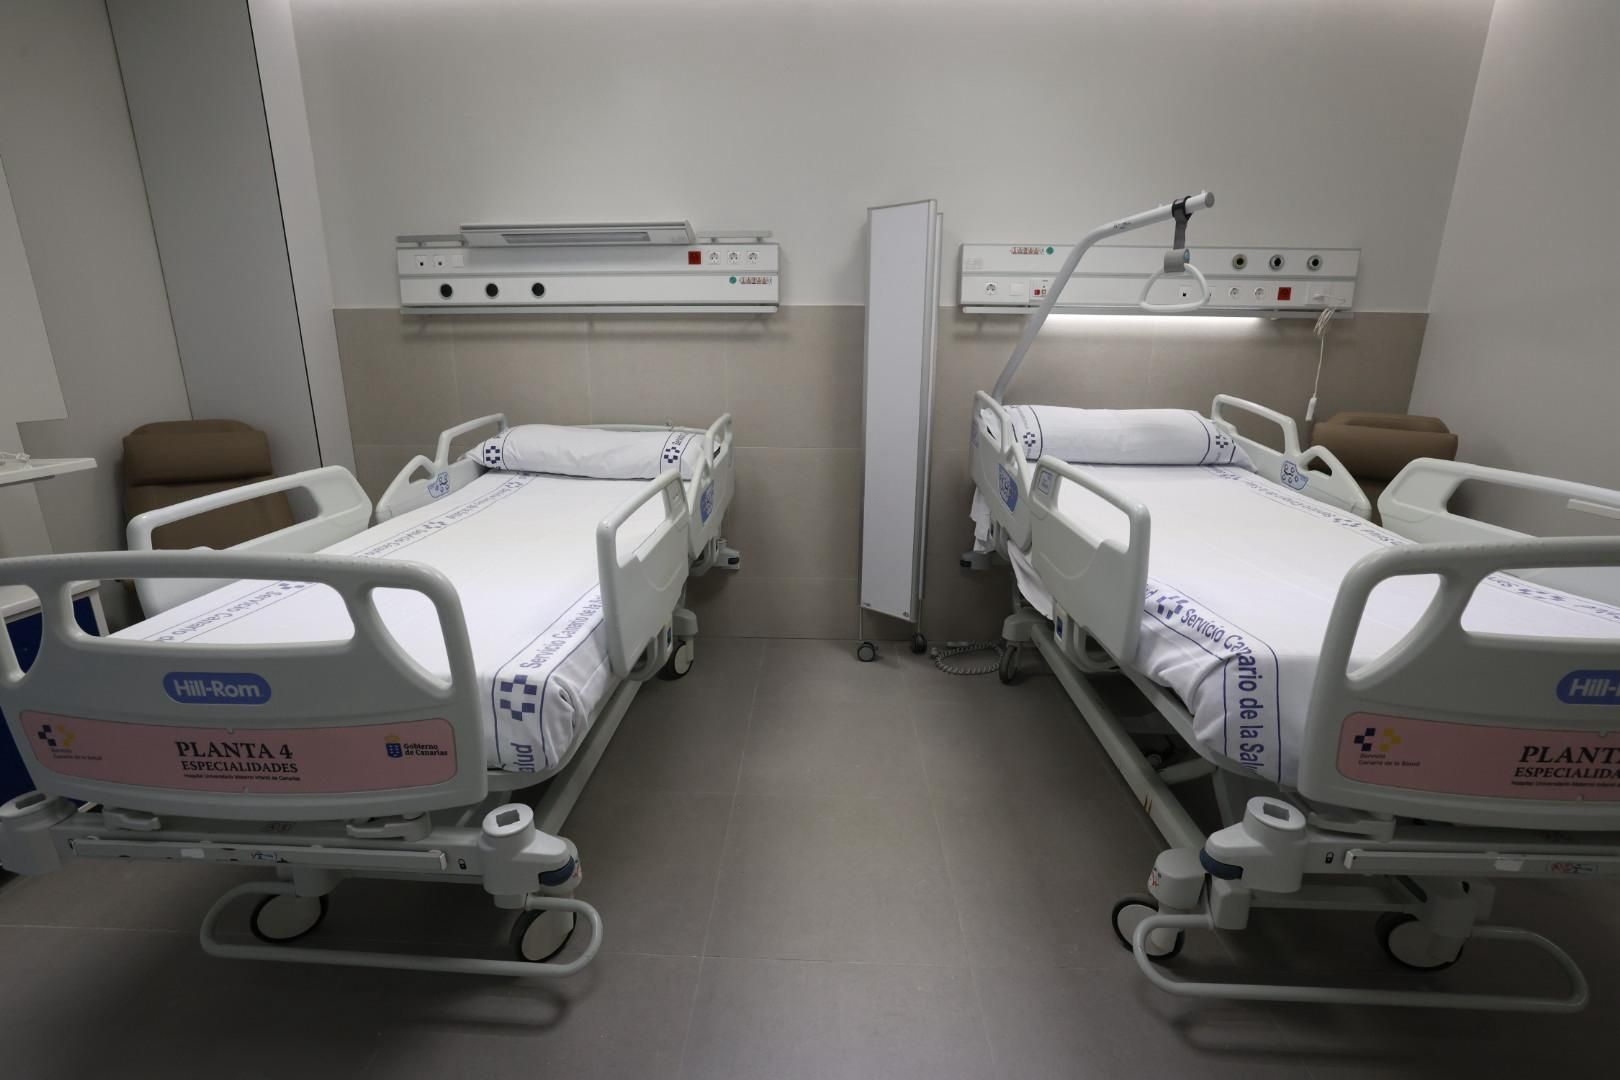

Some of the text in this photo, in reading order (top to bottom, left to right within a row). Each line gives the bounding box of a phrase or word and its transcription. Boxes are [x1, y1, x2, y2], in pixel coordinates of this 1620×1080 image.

[519, 640, 566, 669] Servicio
[173, 679, 260, 698] Hill-Rom
[1181, 608, 1265, 768] Servicio Canario de la Sal
[175, 741, 293, 759] PLANTA 4
[1518, 746, 1620, 764] PLANT
[181, 760, 299, 773] ESPECIALIDADES
